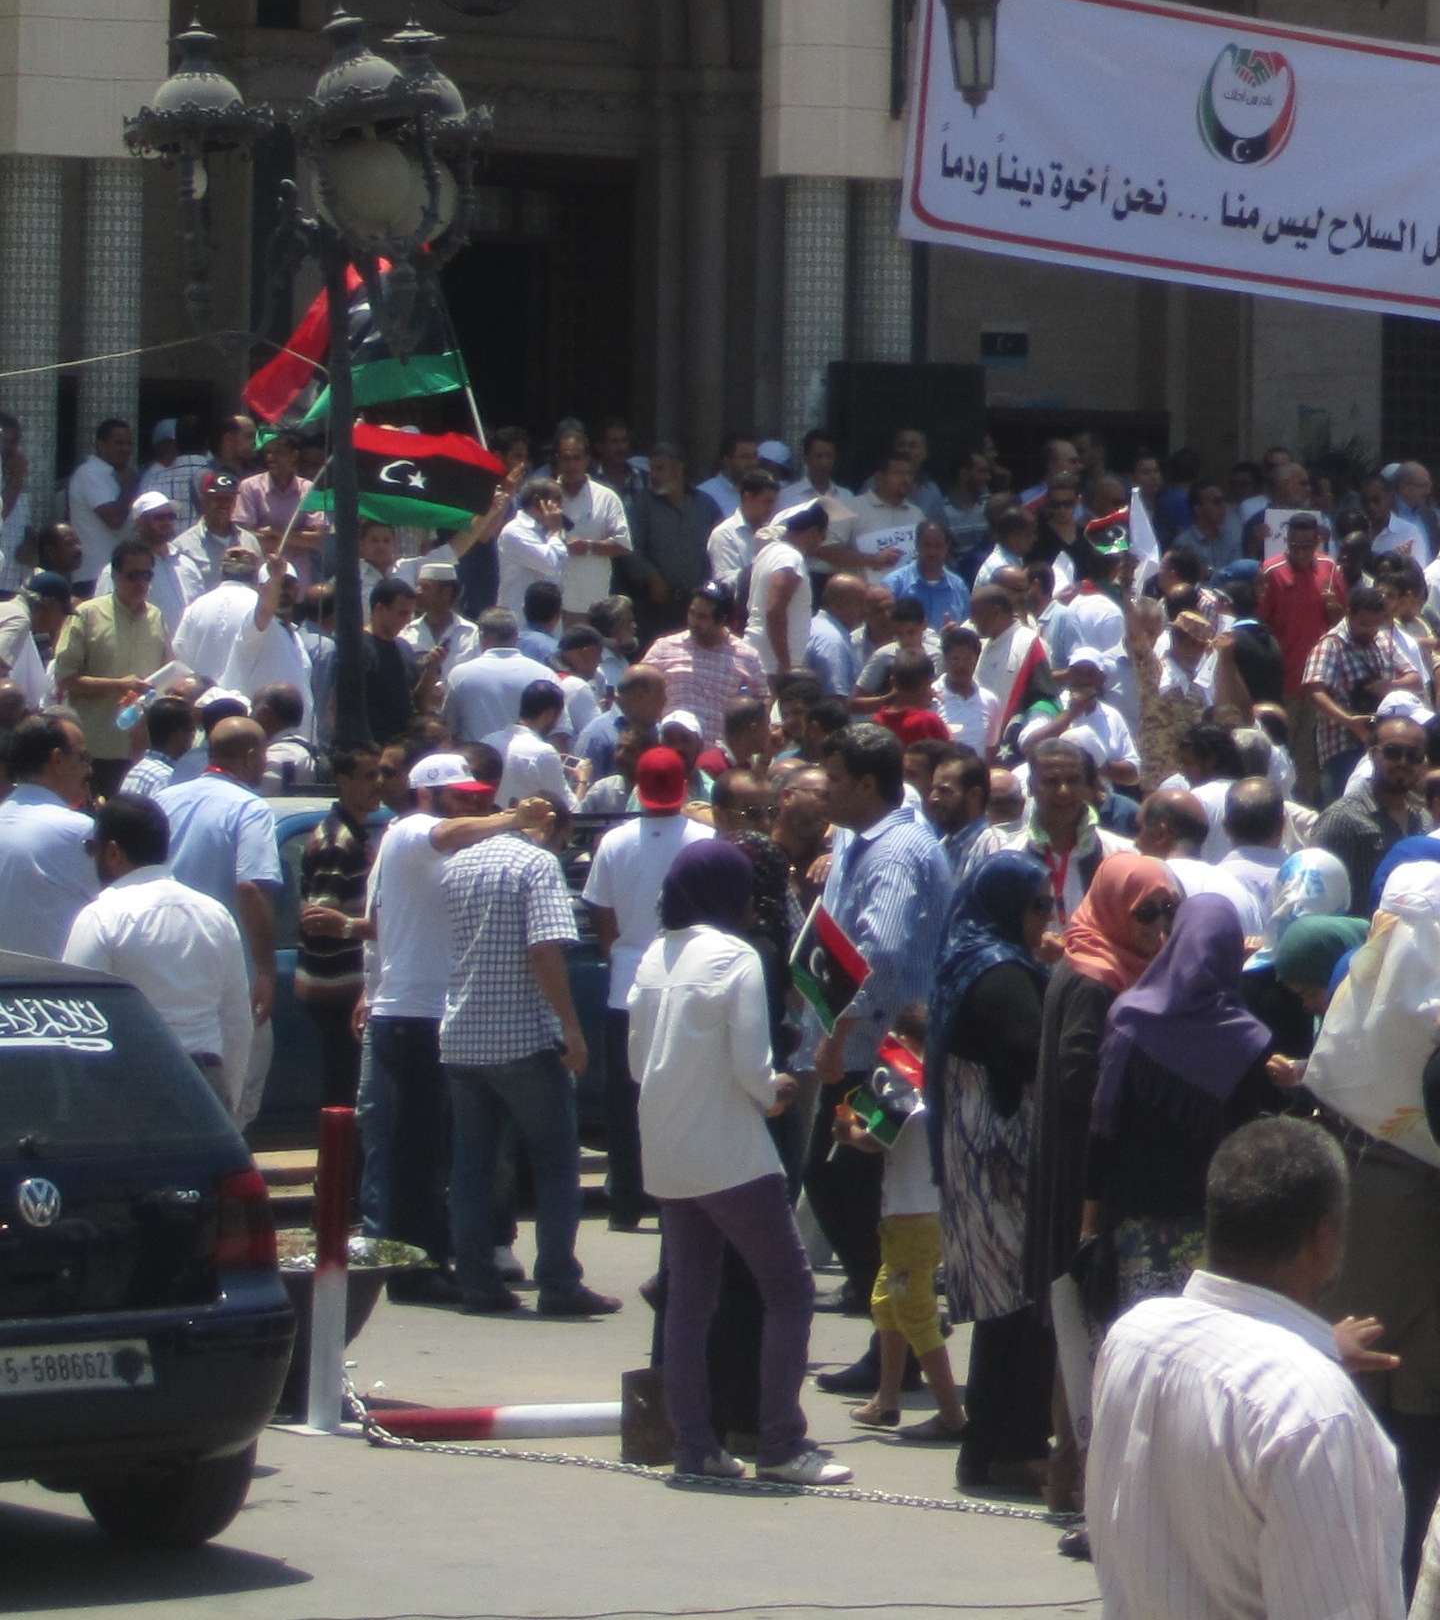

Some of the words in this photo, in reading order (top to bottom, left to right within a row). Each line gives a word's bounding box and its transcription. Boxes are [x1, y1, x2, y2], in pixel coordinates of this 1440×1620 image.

[1113, 178, 1167, 219] نحن
[1220, 193, 1259, 230] منا
[1263, 207, 1323, 244] ليس
[1329, 208, 1415, 254] السلاح
